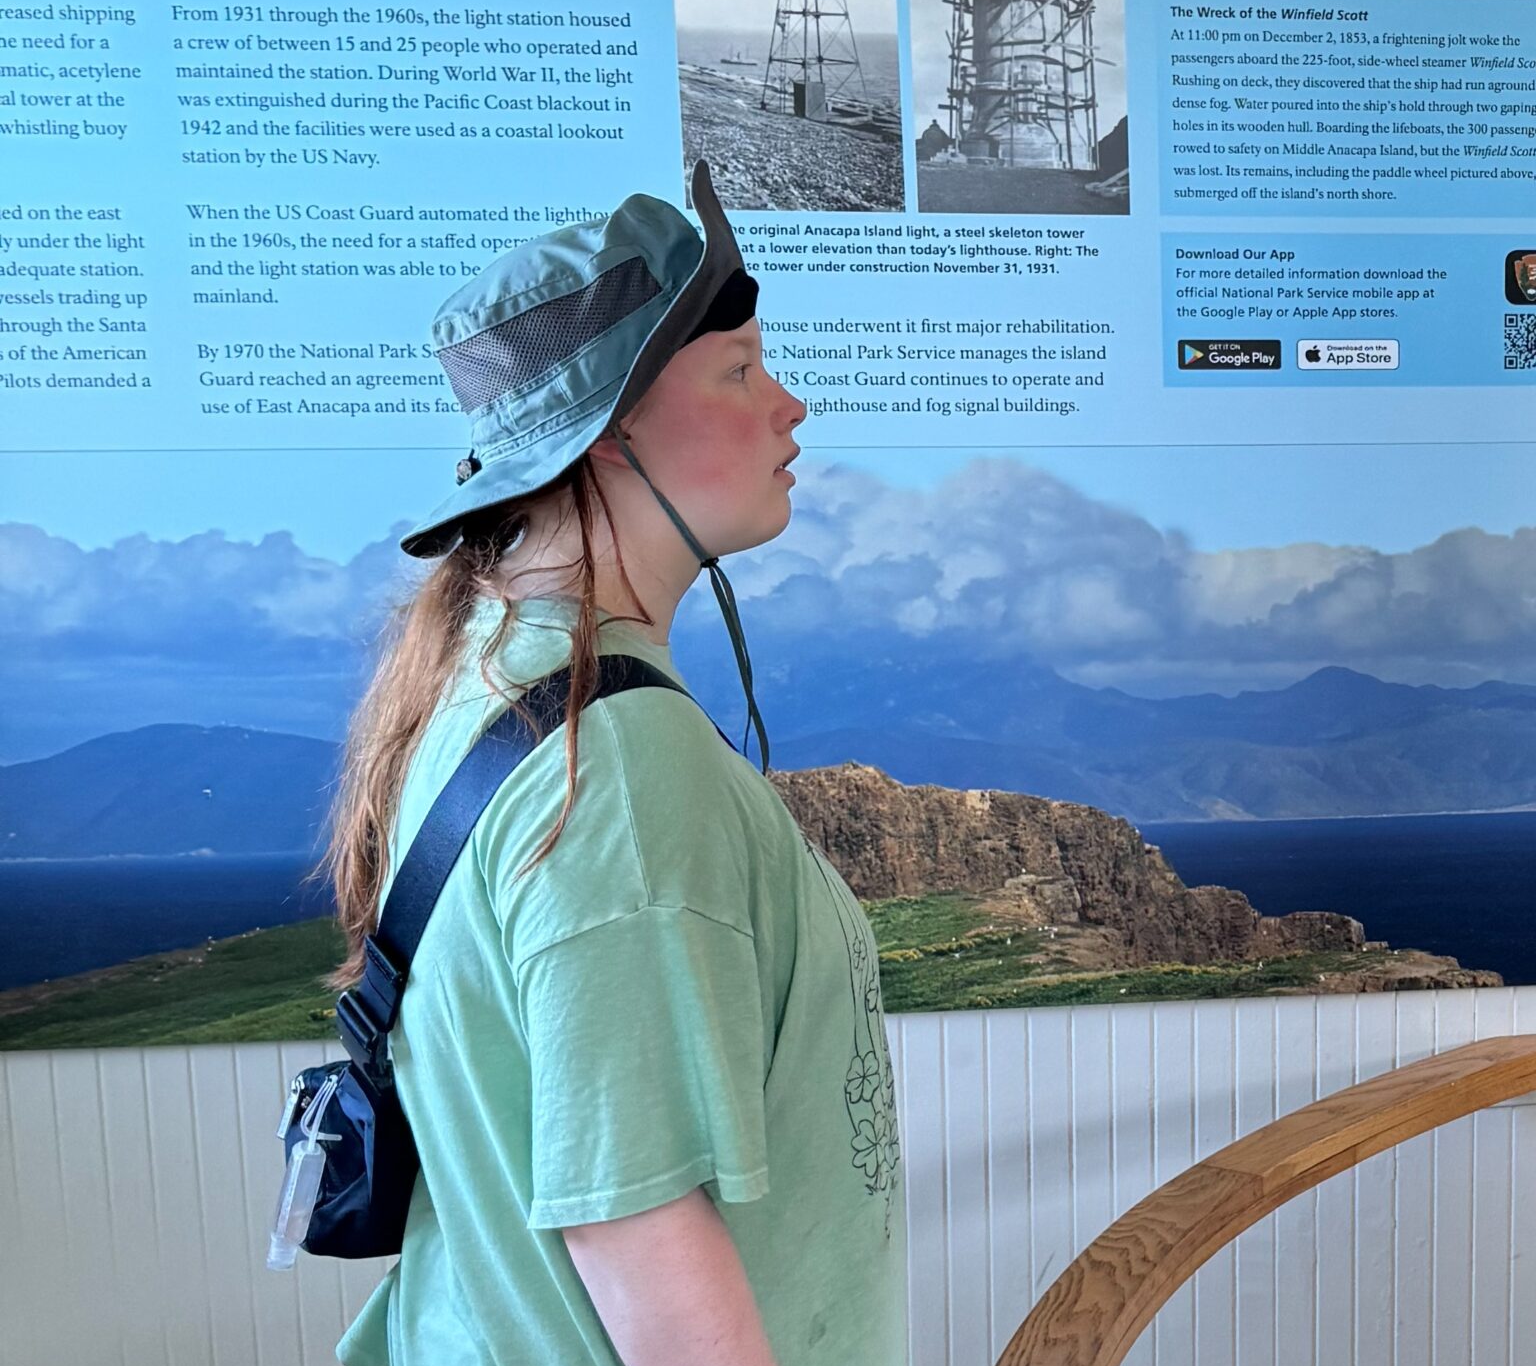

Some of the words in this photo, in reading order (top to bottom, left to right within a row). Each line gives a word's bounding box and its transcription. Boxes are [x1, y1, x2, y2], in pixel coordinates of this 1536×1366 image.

[1169, 5, 1193, 17] The
[1196, 6, 1235, 18] Wreck
[1239, 6, 1253, 19] of
[1256, 6, 1277, 19] the
[1281, 8, 1334, 20] Winfield
[1336, 9, 1368, 21] Scott
[1170, 28, 1184, 40] At
[1188, 29, 1219, 41] 11:00
[1221, 32, 1241, 45] pm
[1243, 32, 1259, 42] on
[1262, 30, 1323, 43] December
[1325, 31, 1336, 45] 2,
[1340, 31, 1370, 45] 1853,
[1372, 35, 1379, 44] a
[1382, 32, 1446, 49] frightening
[1446, 33, 1466, 48] jolt
[1468, 33, 1500, 46] woke
[1502, 34, 1520, 46] the
[82, 119, 127, 140] buoy
[1175, 247, 1239, 259] Download
[1242, 248, 1266, 259] Our
[1269, 249, 1295, 262] App
[79, 261, 144, 277] station.
[763, 261, 803, 272] tower
[807, 260, 846, 272] under
[849, 260, 929, 273] construction
[933, 261, 1000, 273] November
[1003, 262, 1022, 275] 31,
[1026, 262, 1059, 274] 1931.
[1175, 267, 1196, 279] For
[1199, 269, 1231, 279] more
[1234, 267, 1284, 279] detailed
[1288, 267, 1360, 279] information
[1363, 267, 1423, 279] download
[1426, 267, 1447, 279] the
[192, 287, 278, 303] mainland.
[1175, 286, 1217, 298] official
[1221, 286, 1273, 298] National
[1277, 286, 1304, 298] Park
[1306, 287, 1348, 298] Service
[1352, 286, 1393, 298] mobile
[1396, 289, 1419, 301] app
[1422, 288, 1434, 298] at
[1176, 305, 1197, 317] the
[1200, 305, 1245, 320] Google
[1248, 305, 1273, 320] Play
[1275, 308, 1289, 317] or
[1292, 306, 1328, 320] Apple
[1331, 306, 1357, 320] App
[1359, 307, 1398, 317] stores.
[781, 343, 852, 359] National
[857, 344, 893, 359] Park
[897, 344, 955, 359] Service
[959, 349, 1027, 364] manages
[1031, 345, 1056, 359] the
[1060, 344, 1106, 359] island
[1208, 352, 1250, 366] Google
[1252, 352, 1275, 366] Play
[1326, 353, 1354, 365] App
[1357, 353, 1392, 363] Store
